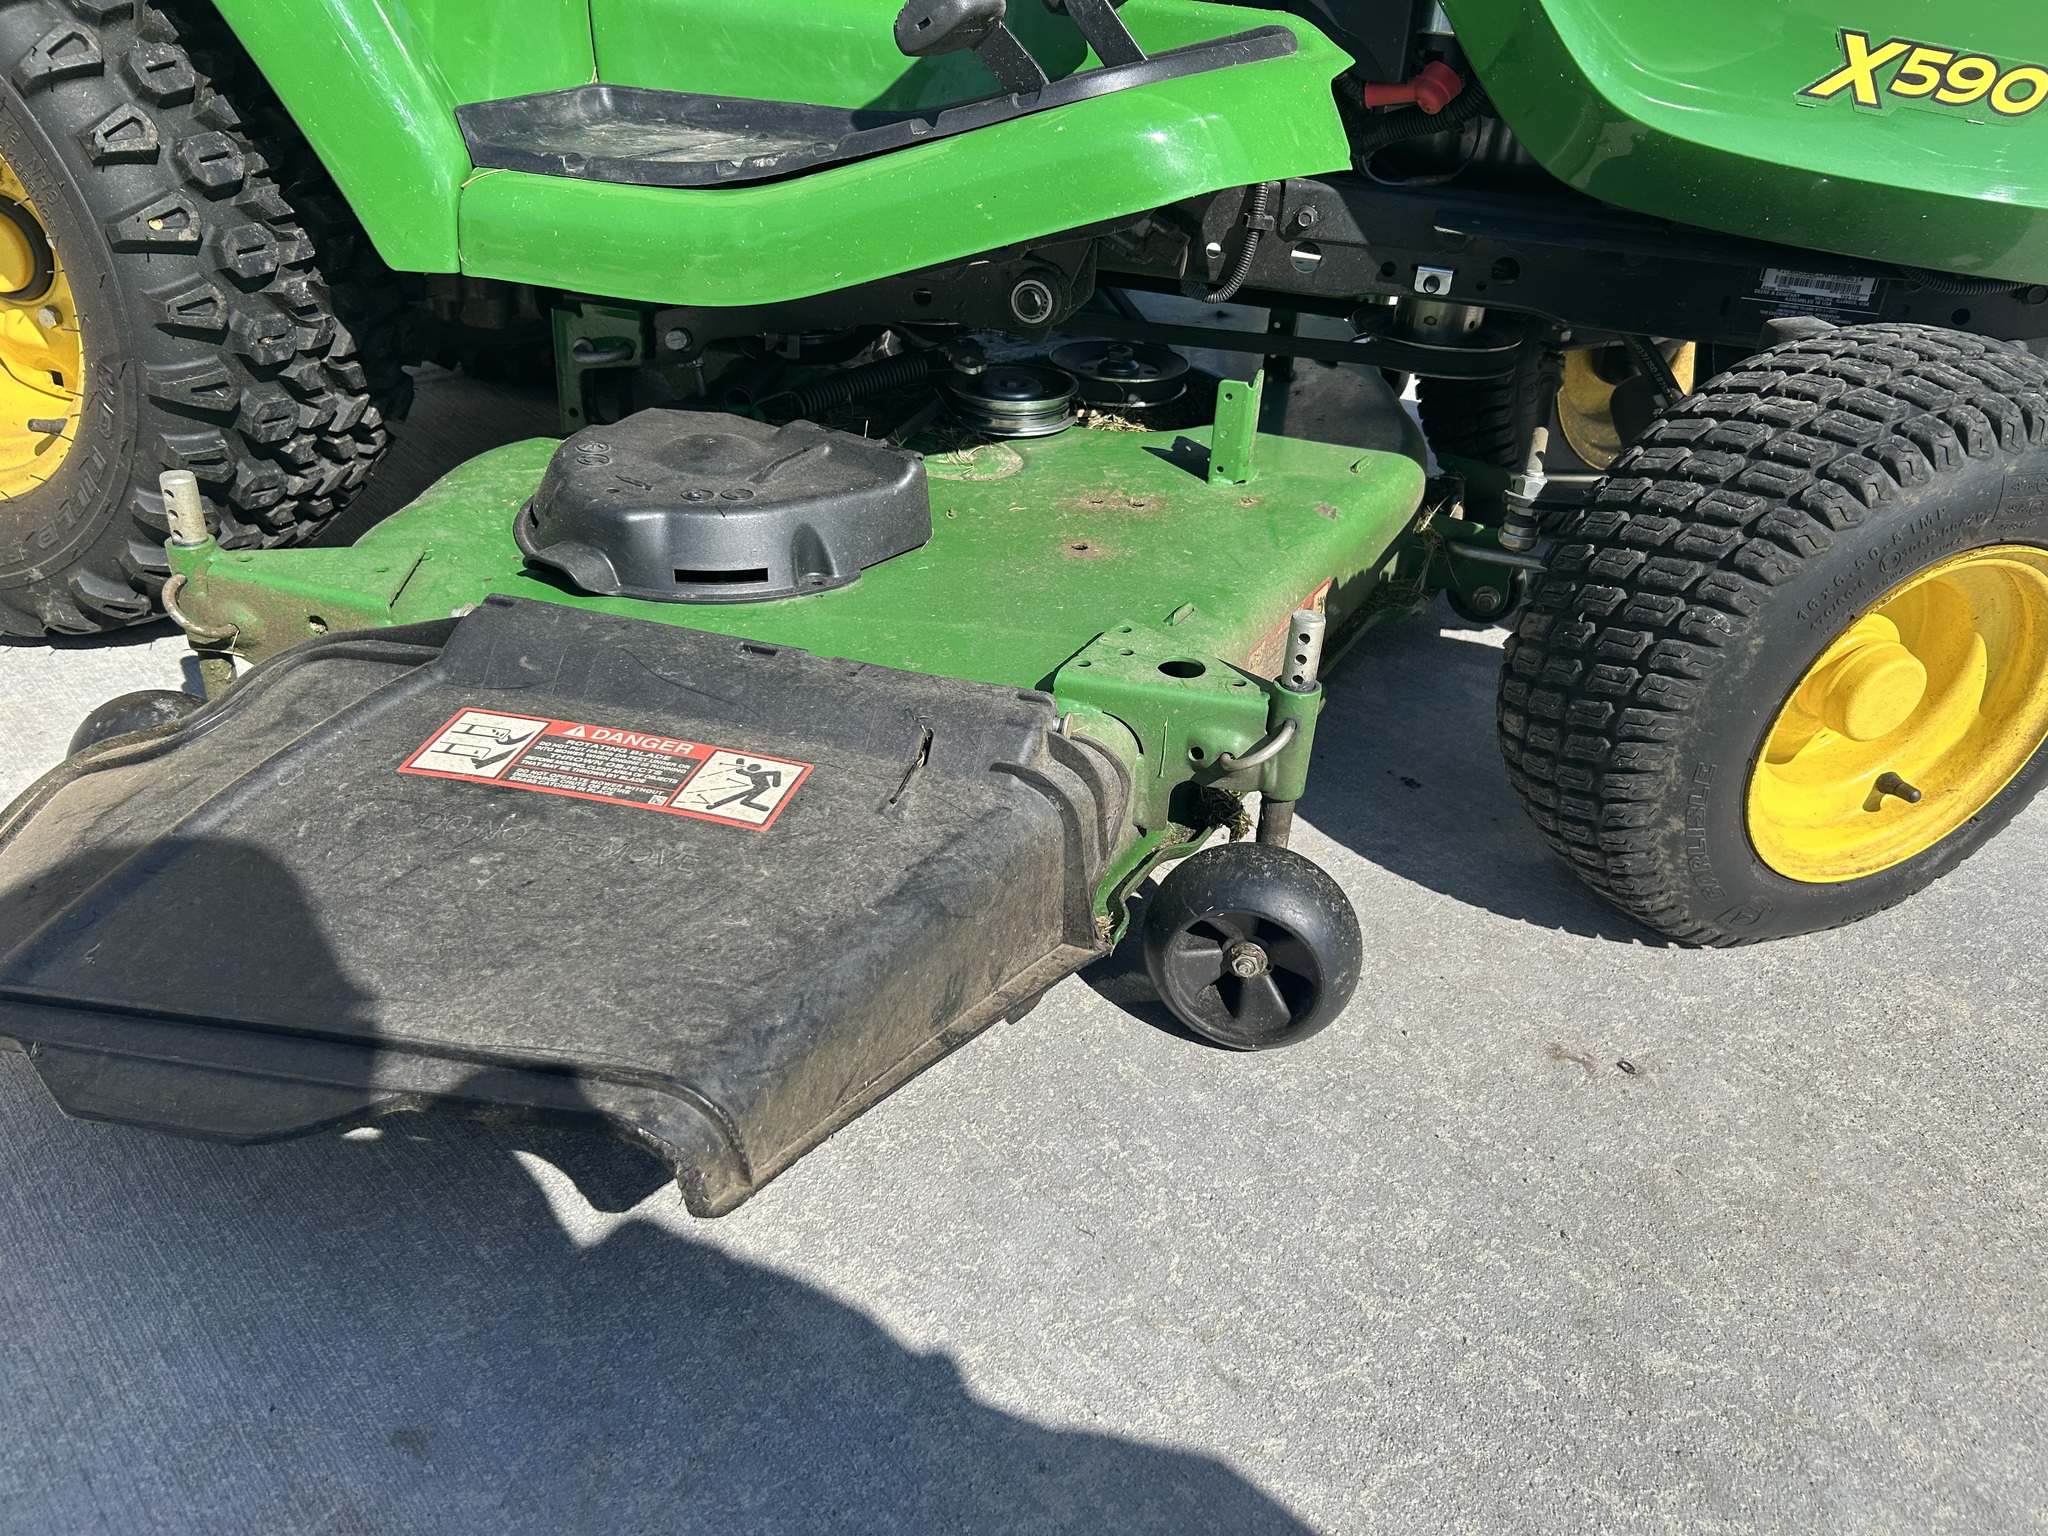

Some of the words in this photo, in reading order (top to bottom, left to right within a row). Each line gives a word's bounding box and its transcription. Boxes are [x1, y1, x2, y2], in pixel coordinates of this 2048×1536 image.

[1798, 32, 2048, 116] X590
[36, 445, 107, 551] FIELD
[564, 739, 629, 753] ROTATING
[629, 749, 673, 760] BLADE
[589, 728, 695, 755] DANGER
[524, 755, 555, 764] BEFORE
[553, 759, 587, 768] MOWING,
[585, 765, 612, 773] CLEAR
[610, 769, 633, 777] AREA
[643, 774, 679, 783] OBJECTS
[547, 752, 604, 765] THROWN
[603, 761, 664, 775] OBJECTS
[553, 748, 585, 757] MOWER
[584, 753, 610, 761] WHEN
[608, 757, 640, 766] ENGINE
[649, 764, 687, 773] RUNNING
[585, 748, 615, 757] HANDS
[626, 755, 649, 763] FEET
[647, 758, 678, 767] UNDER
[511, 771, 559, 782] DISCHARGE
[558, 779, 587, 788] CHUTE
[600, 786, 631, 795] ENTIRE
[520, 759, 542, 767] THAT
[540, 762, 559, 770] MAY
[571, 767, 606, 776] THROWN
[618, 775, 646, 784] BLADE
[548, 773, 590, 783] OPERATE
[589, 779, 623, 788] MOWER
[623, 785, 664, 795] WITHOUT
[508, 775, 538, 784] GRASS
[537, 780, 577, 789] CATCHER
[585, 788, 614, 796] PLACE
[1684, 761, 1727, 902] CARLISLE
